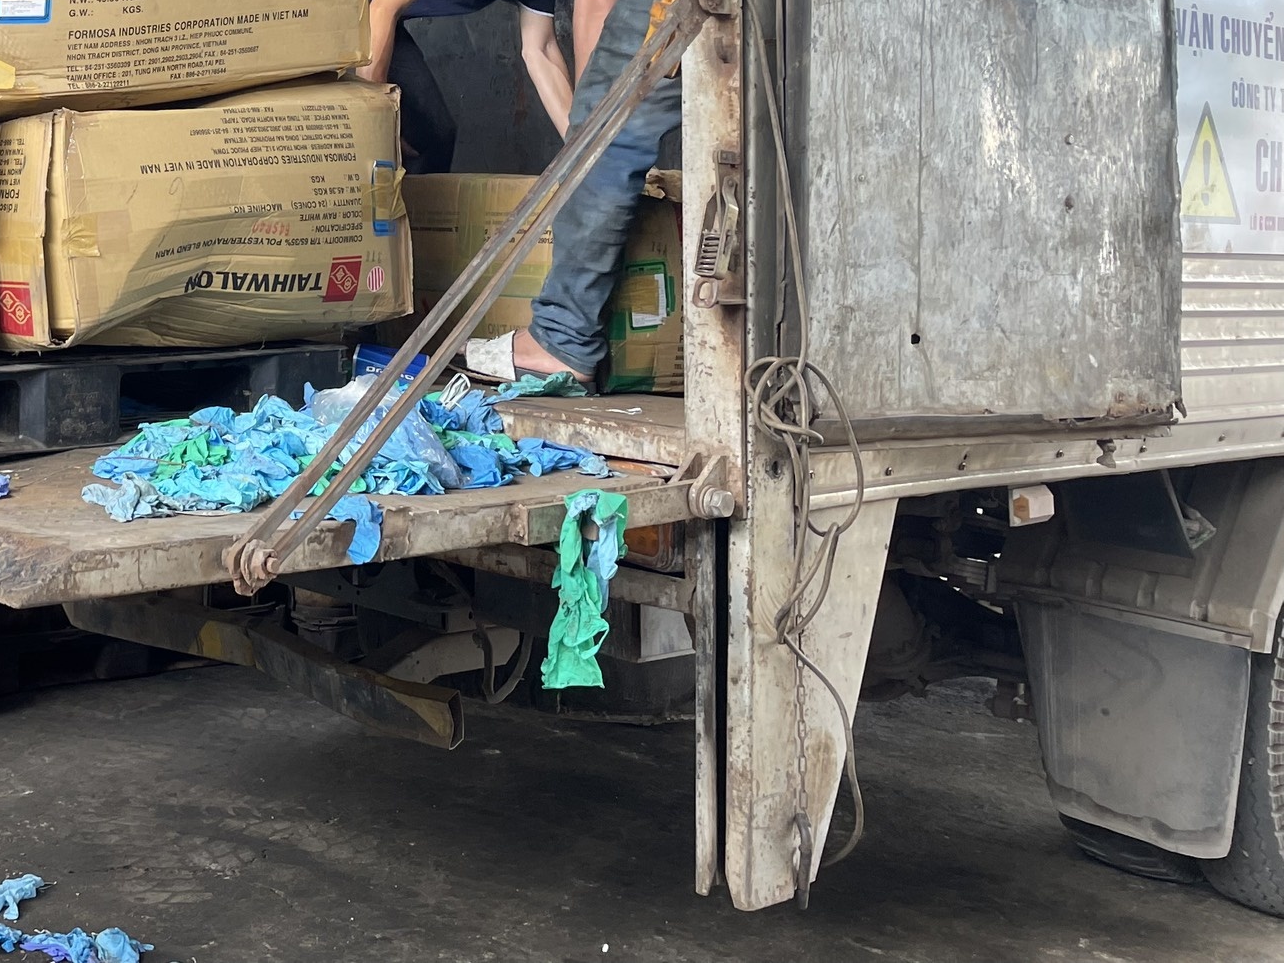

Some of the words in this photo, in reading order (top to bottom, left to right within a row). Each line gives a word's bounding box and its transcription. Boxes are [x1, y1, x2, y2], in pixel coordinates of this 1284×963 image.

[68, 28, 116, 40] FORMOSA
[119, 23, 171, 37] INDUSTRIES
[174, 16, 234, 31] CORPORATION
[237, 13, 260, 24] MADE
[262, 13, 270, 21] IN
[272, 10, 290, 20] VIET
[292, 8, 309, 19] NAM
[1176, 4, 1214, 57] VẬN
[100, 40, 131, 49] ADDRESS
[154, 35, 173, 44] TRACH
[203, 30, 223, 38] PHUOC
[88, 52, 110, 60] TRACH
[142, 46, 159, 54] DONG
[202, 39, 227, 48] VIETNAM
[66, 74, 92, 82] TAIWAN
[93, 71, 116, 79] OFFICE
[167, 63, 187, 72] NORTH
[1232, 77, 1260, 110] CÔNG
[1263, 86, 1277, 112] TY
[222, 156, 279, 168] CORPORATION
[281, 154, 323, 164] INDUSTRIES
[324, 153, 356, 162] FORMOSA
[140, 164, 161, 174] NAM
[164, 162, 184, 172] VIET
[185, 161, 195, 171] IN
[196, 159, 221, 169] MADE
[245, 203, 283, 213] MACHINE
[291, 201, 317, 210] CONES)
[299, 213, 321, 221] WHITE
[323, 211, 337, 219] RAW
[177, 241, 201, 253] BLEND
[203, 237, 283, 247] POLYESTER/RAYON
[155, 247, 175, 259] YARN
[184, 271, 323, 293] TAIHWALON
